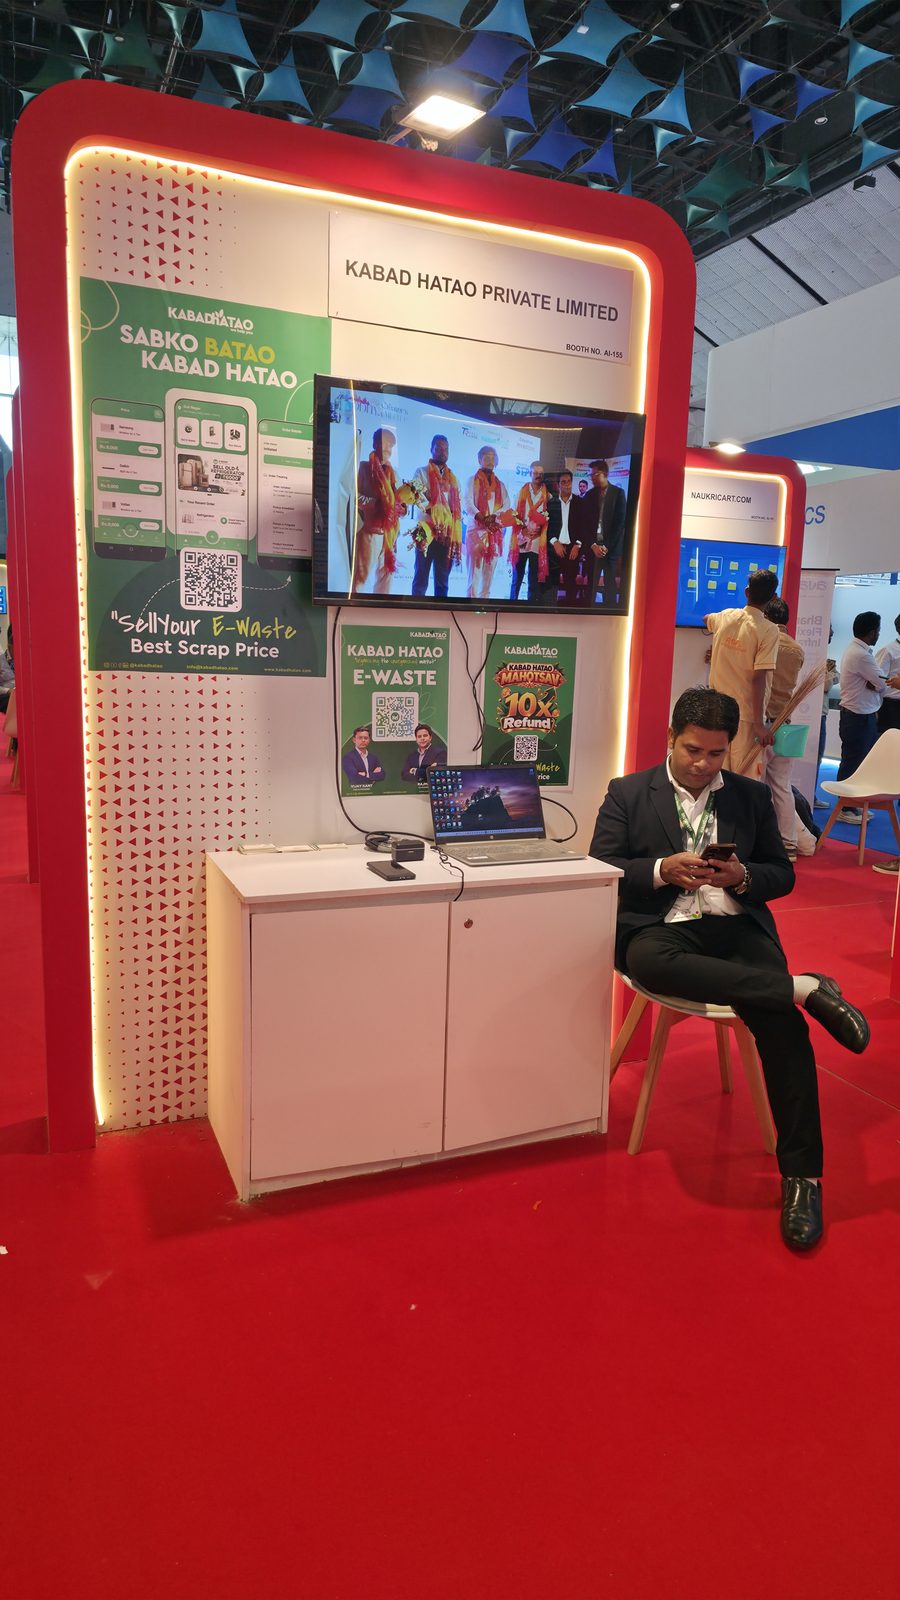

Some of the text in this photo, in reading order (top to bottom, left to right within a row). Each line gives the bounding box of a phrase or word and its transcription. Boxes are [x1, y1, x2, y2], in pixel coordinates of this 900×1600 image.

[345, 259, 619, 322] KABAD HATAO PRIVATE LIMITED
[120, 324, 276, 364] SABKO BATAO
[566, 343, 623, 359] BOOTH NO. AI-155
[141, 350, 298, 389] KABAD HATAO
[691, 491, 752, 504] NAUKRICART.COM
[212, 614, 297, 640] E-Waste
[130, 638, 280, 659] Best Scrap Price
[347, 644, 444, 658] KABAD HATAO
[532, 664, 553, 672] HATAO
[353, 669, 437, 686] E-WASTE
[501, 671, 560, 686] MAHOTSAV
[504, 692, 553, 718] 10x
[503, 717, 551, 730] Refund
